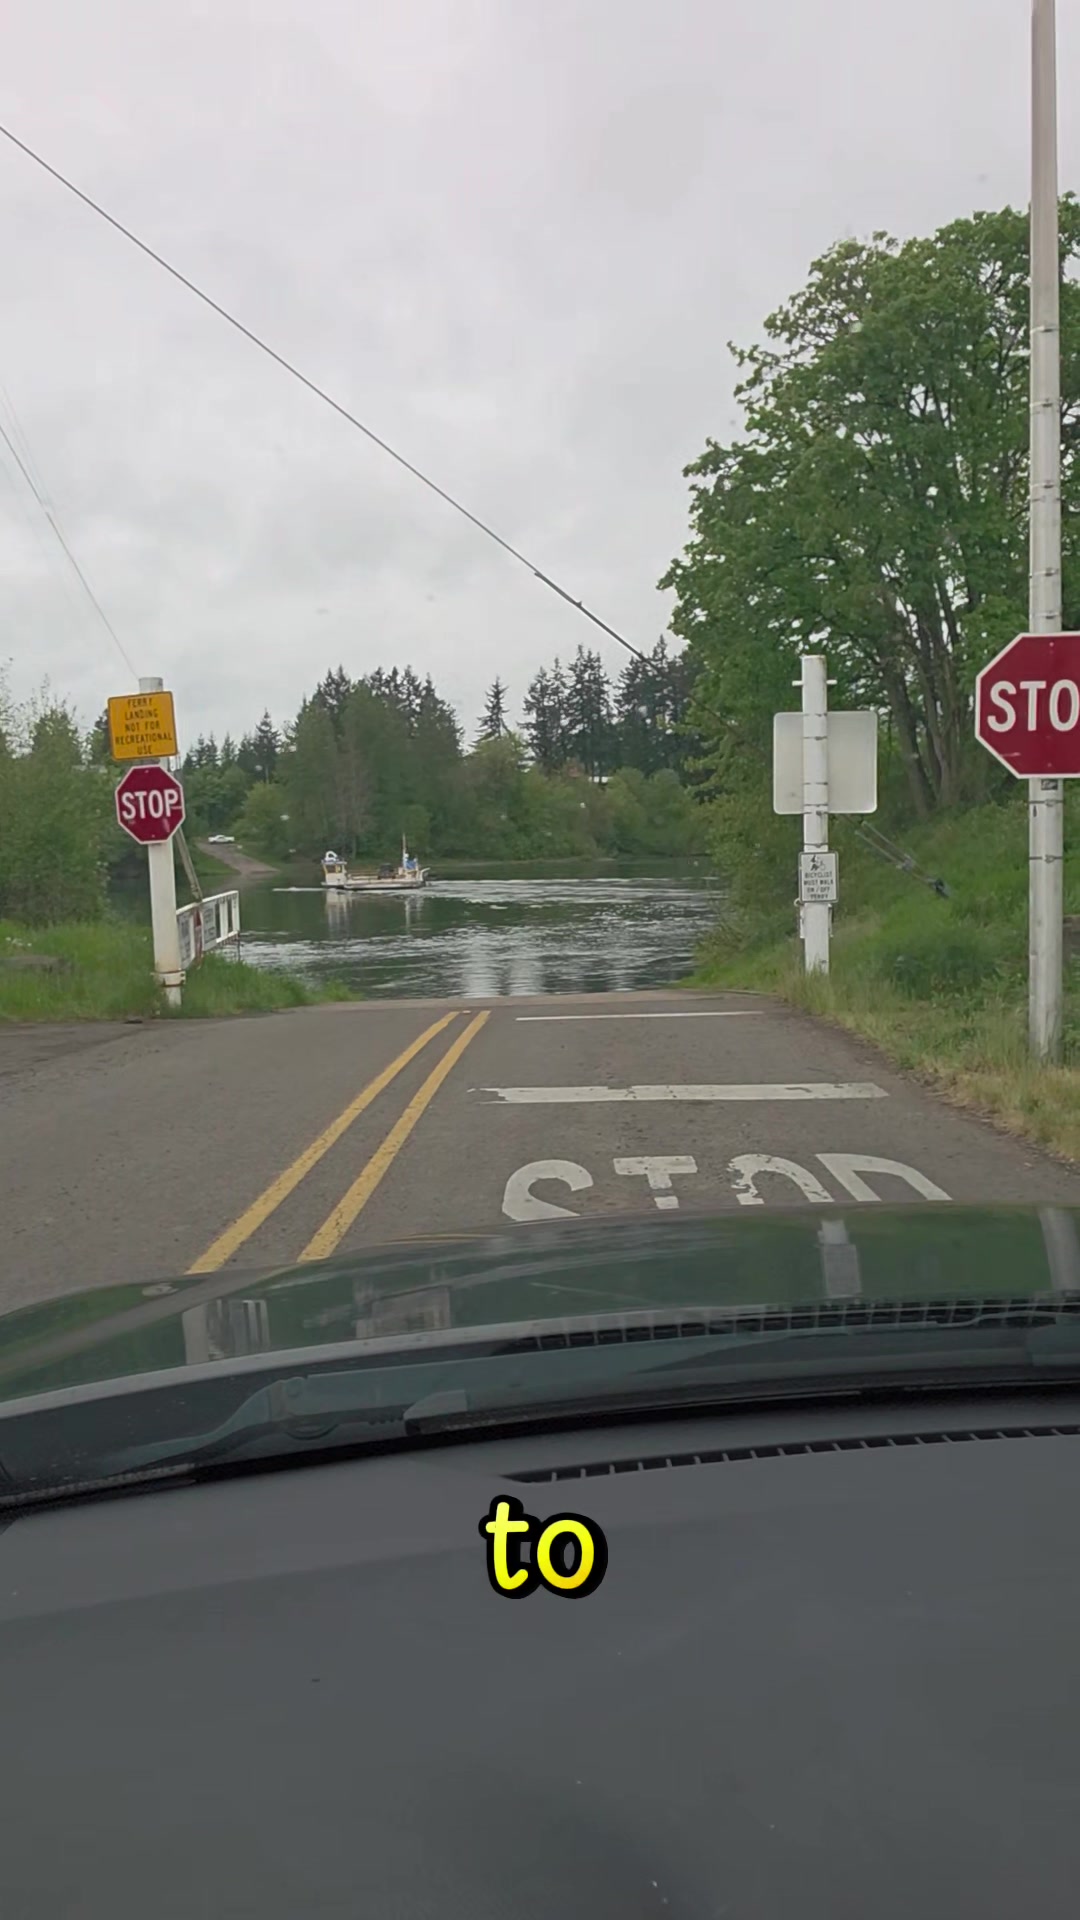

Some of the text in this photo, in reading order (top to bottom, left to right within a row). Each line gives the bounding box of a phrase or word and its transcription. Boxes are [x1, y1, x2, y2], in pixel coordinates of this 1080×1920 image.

[127, 697, 152, 708] FERRY
[124, 708, 158, 721] LANDING
[124, 720, 160, 732] NOT FOR
[115, 732, 172, 745] RECREATIONAL
[137, 745, 152, 755] USE
[121, 788, 179, 820] STOP
